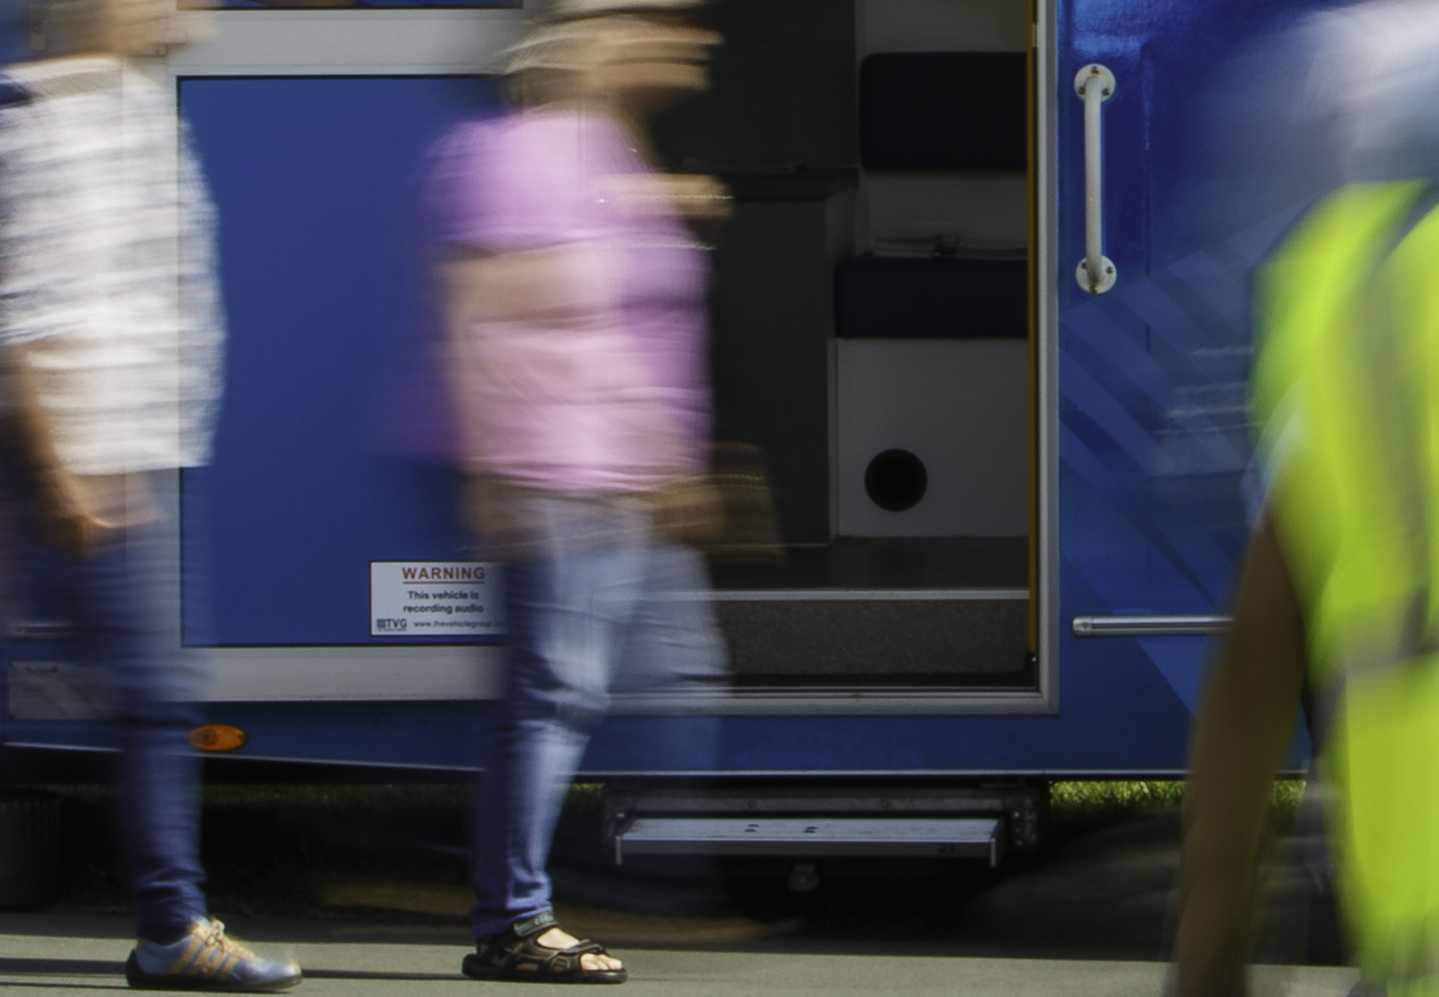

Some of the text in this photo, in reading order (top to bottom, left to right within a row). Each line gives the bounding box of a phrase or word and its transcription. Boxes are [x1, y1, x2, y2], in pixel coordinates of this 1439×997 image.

[402, 567, 485, 579] WARNING
[407, 591, 479, 600] This vehicle is
[403, 604, 484, 615] recording audio
[386, 618, 407, 628] TVG
